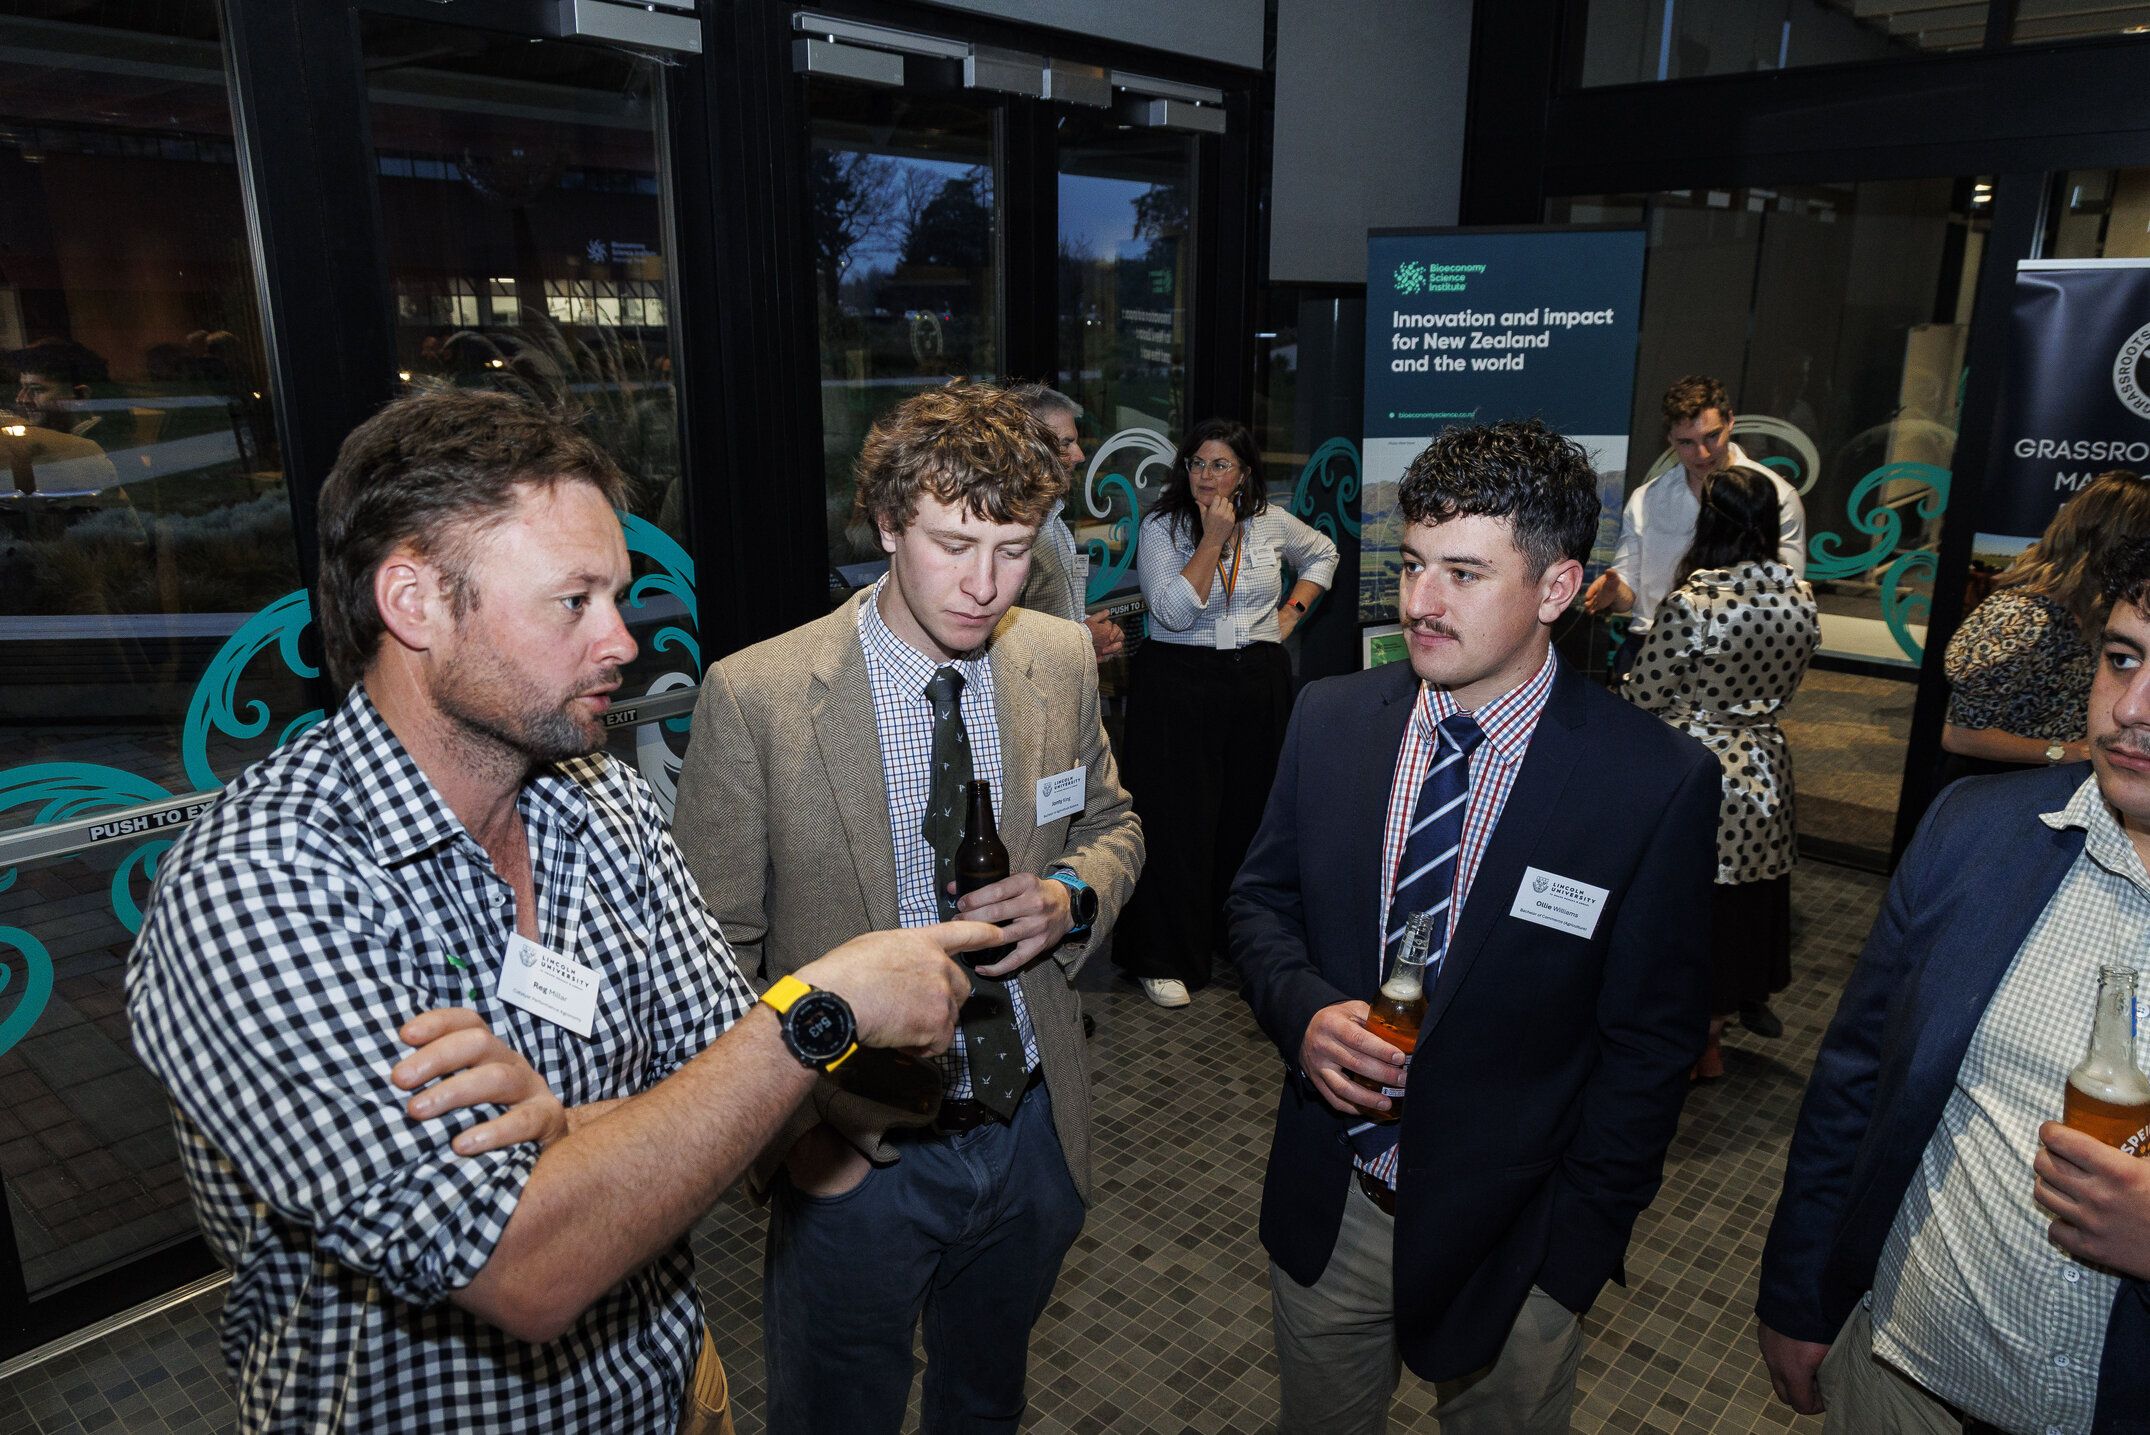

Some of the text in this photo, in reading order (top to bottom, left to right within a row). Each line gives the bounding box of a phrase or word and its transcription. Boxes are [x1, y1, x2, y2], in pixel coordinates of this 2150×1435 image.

[1429, 263, 1487, 274] Bioeconomy
[1429, 273, 1466, 282] Science
[1429, 282, 1467, 292] Institute
[1393, 308, 1615, 329] Innovation and impact
[1392, 330, 1550, 350] for New Zealand
[1391, 353, 1525, 372] and the world
[2014, 438, 2150, 462] GRASSRO
[1110, 603, 1130, 616] PUSH
[1131, 601, 1141, 611] TO
[606, 709, 636, 726] EXIT
[90, 801, 213, 841] PUSH TO EX
[1551, 887, 1596, 904] UNIVERSITY
[1552, 882, 1585, 895] LINCOLN
[1536, 900, 1553, 911] Ollie
[1553, 905, 1579, 918] Williams
[542, 954, 576, 975] LINCOLN
[541, 961, 590, 989] UNIVERSITY
[533, 981, 548, 996] Reg
[2120, 1124, 2150, 1156] SPEI
